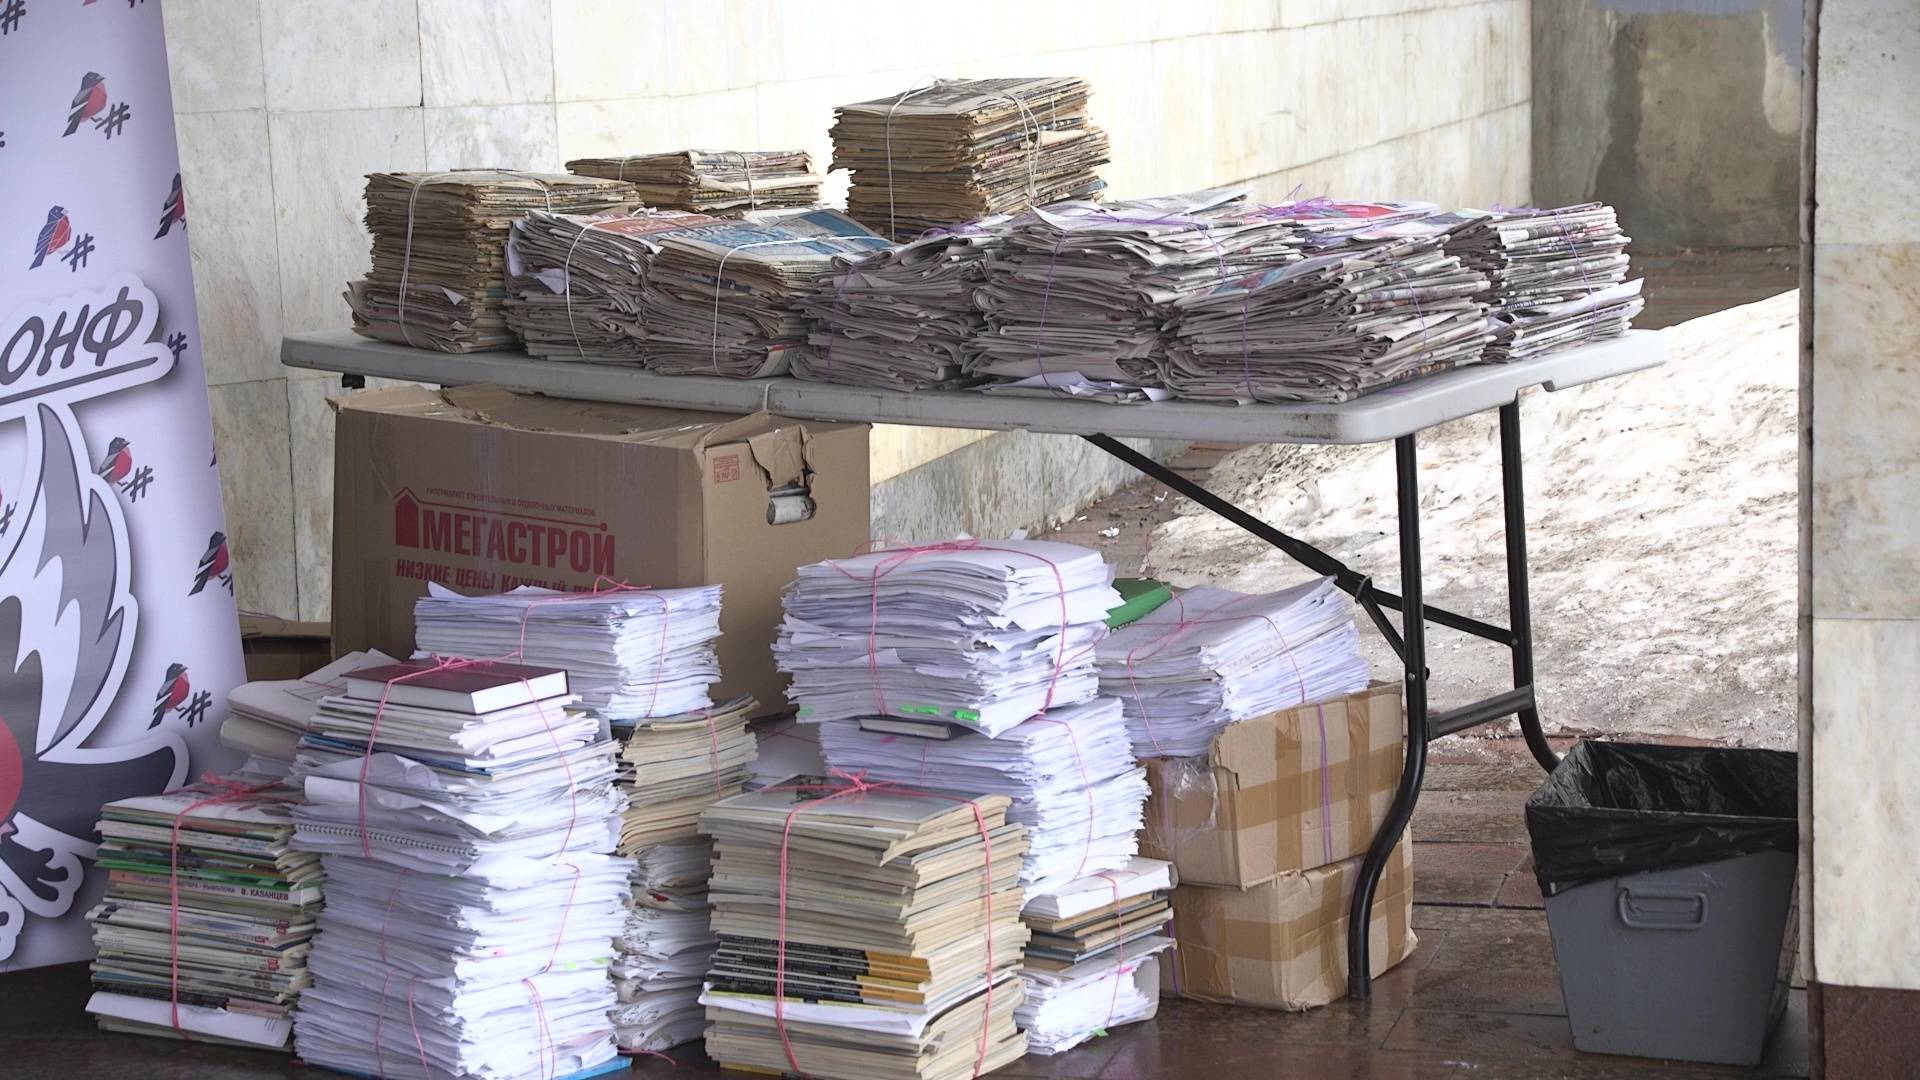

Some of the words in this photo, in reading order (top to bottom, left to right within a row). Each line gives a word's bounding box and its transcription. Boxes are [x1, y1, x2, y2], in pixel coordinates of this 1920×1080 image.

[0, 286, 143, 385] ОНФ
[423, 509, 615, 577] МЕГАСТРОЙ
[396, 559, 450, 584] НИЗКИЕ
[456, 568, 496, 590] ЦЕНЫ
[250, 888, 289, 900] КАЗАНЦЕВ
